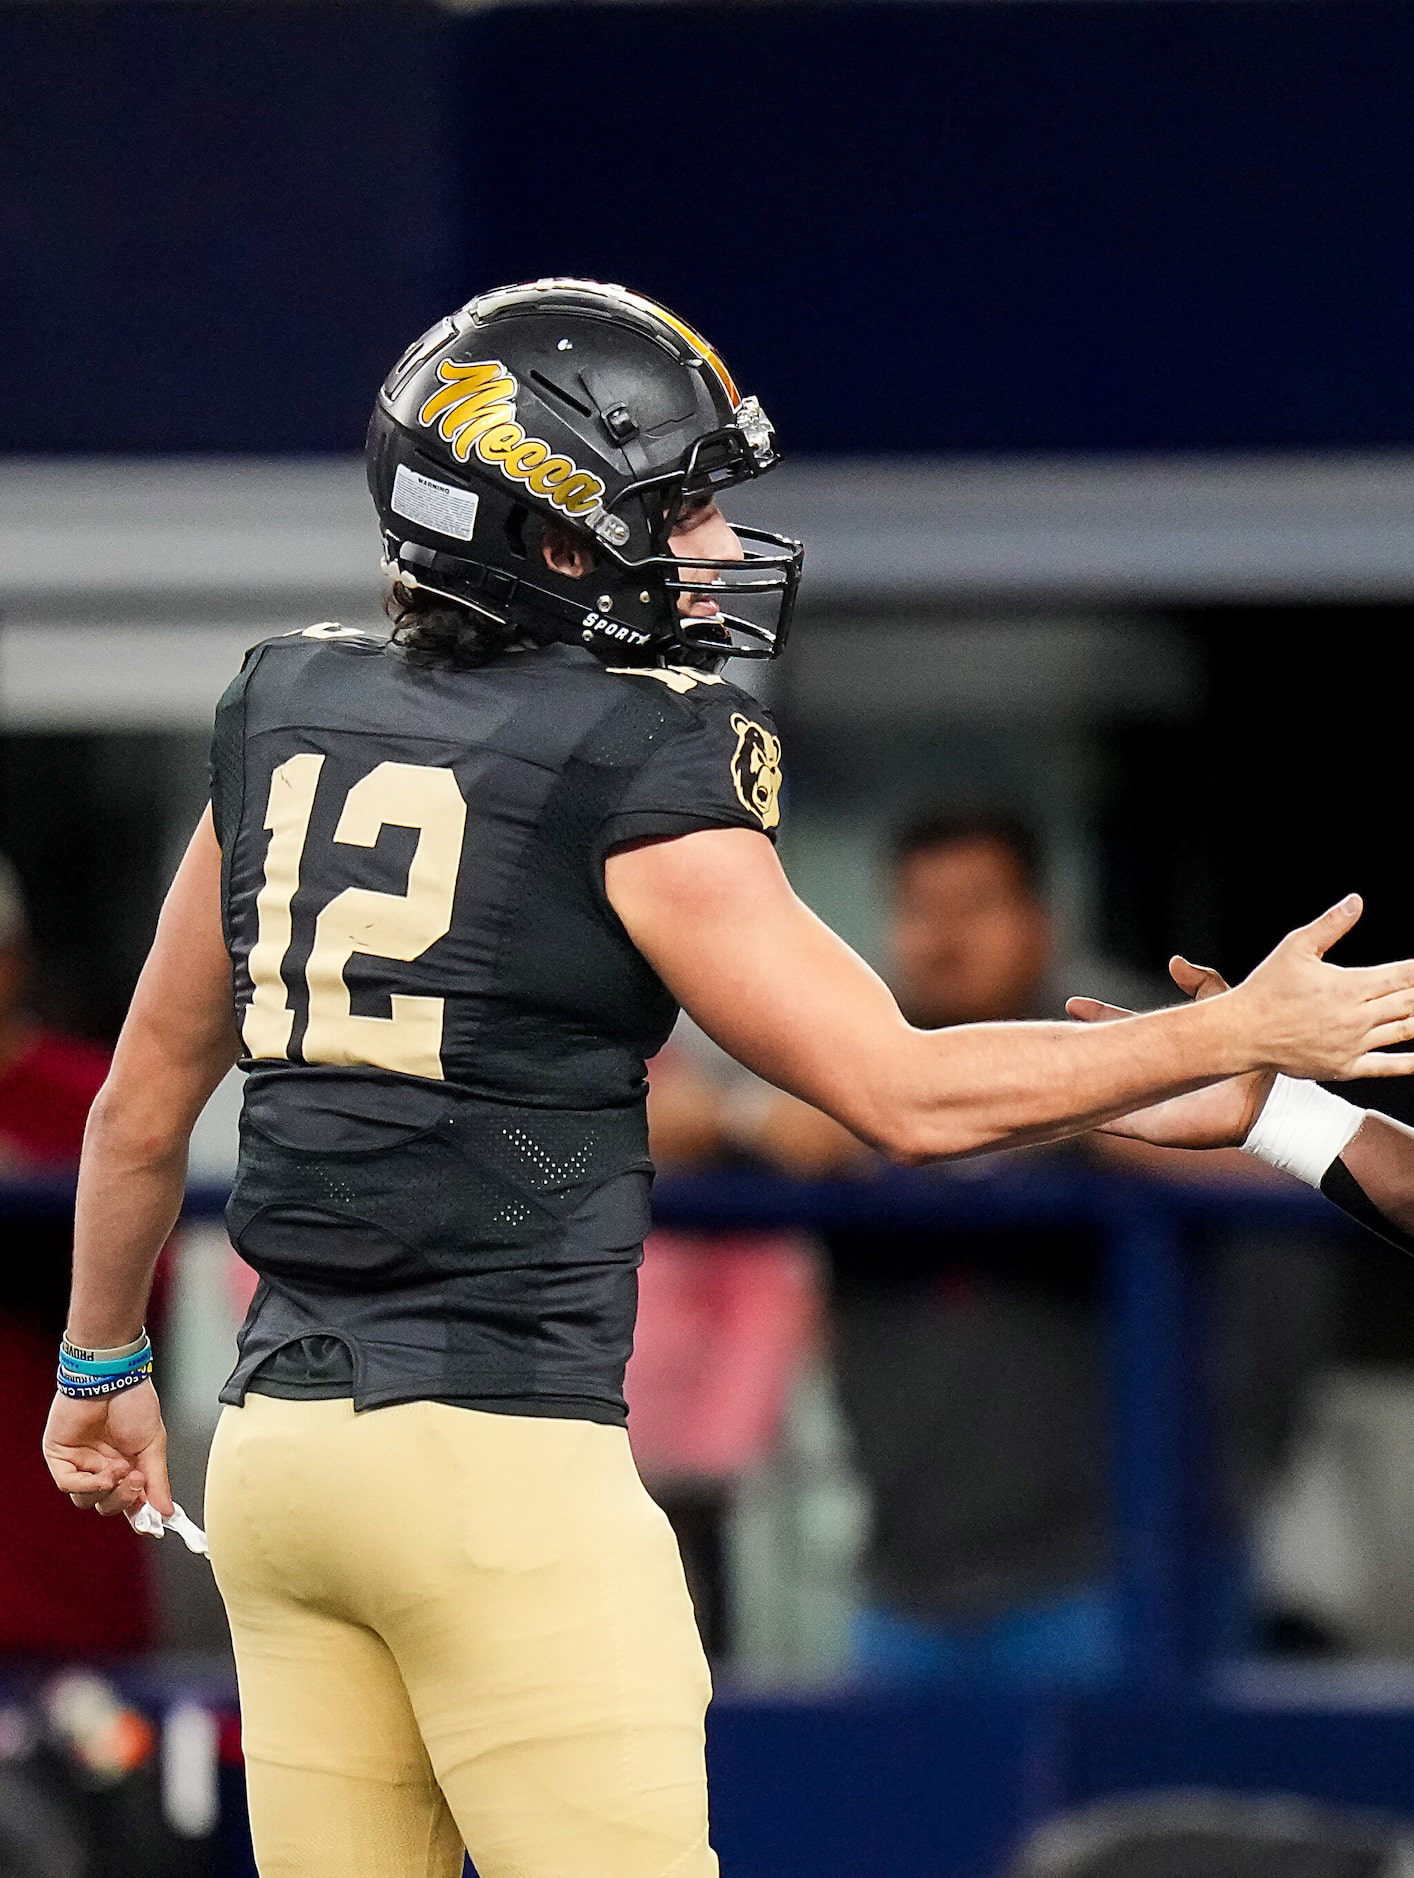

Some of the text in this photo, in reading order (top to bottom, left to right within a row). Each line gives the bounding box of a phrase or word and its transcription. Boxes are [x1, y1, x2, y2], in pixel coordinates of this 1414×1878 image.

[417, 357, 606, 518] Mecca
[417, 477, 451, 495] WARNING
[242, 753, 467, 1080] 12
